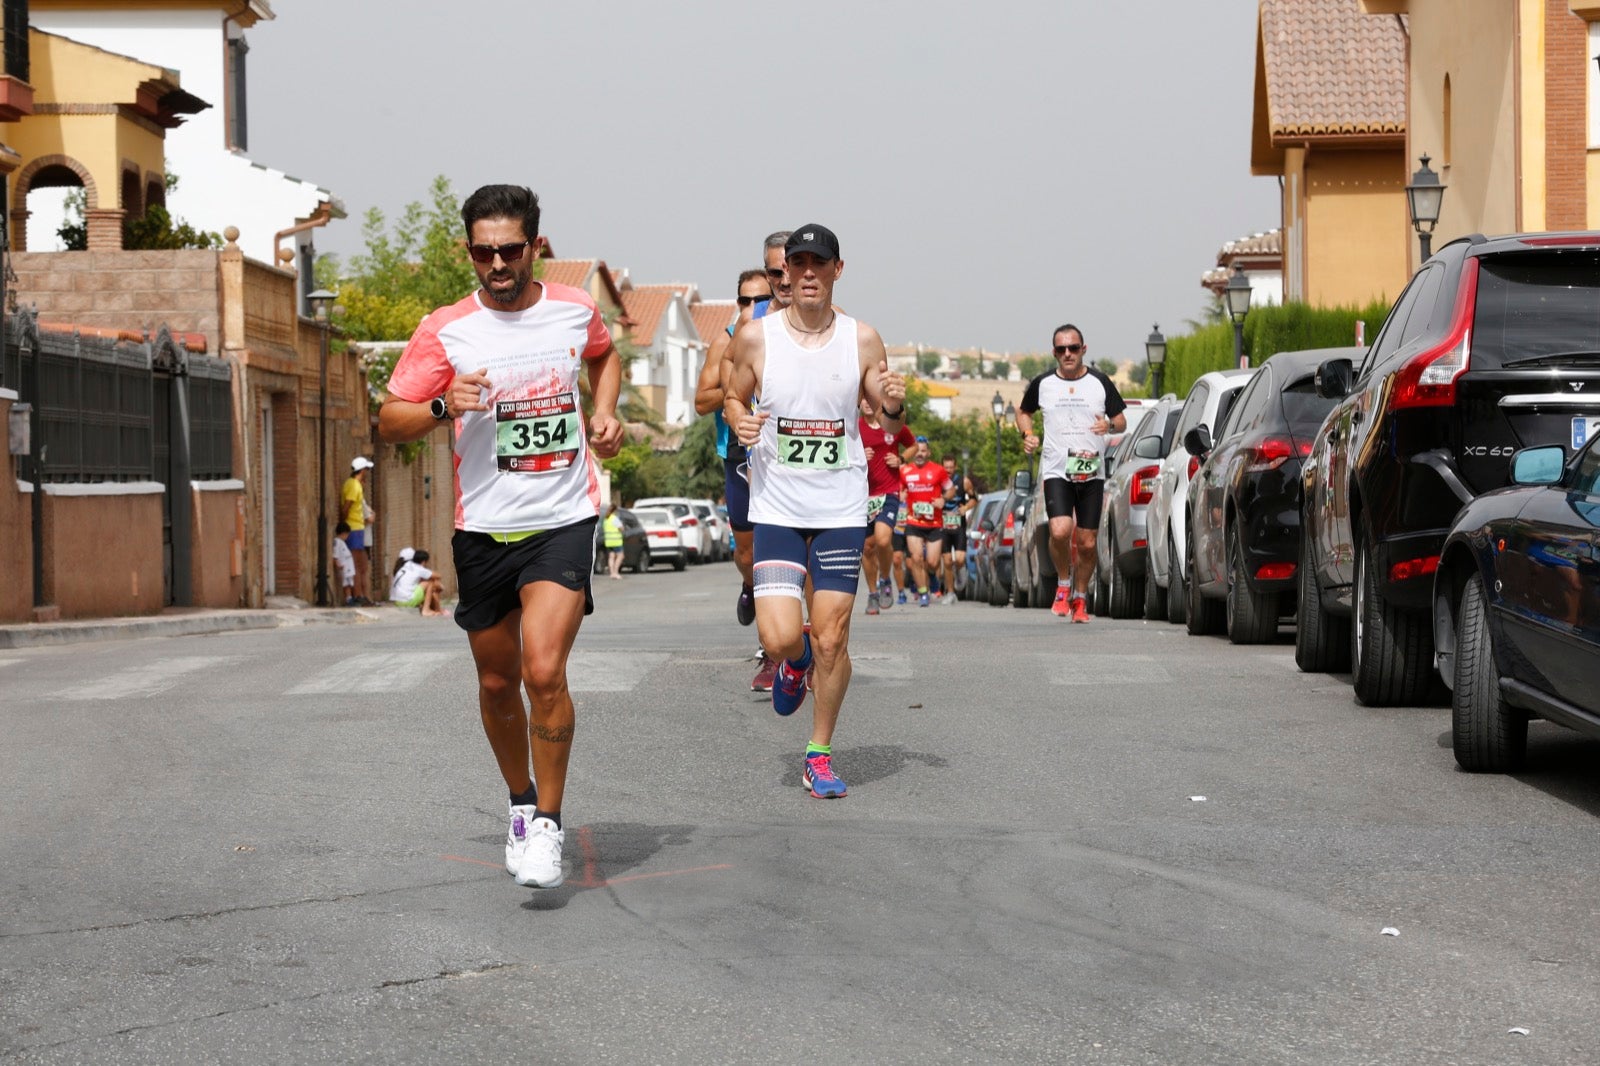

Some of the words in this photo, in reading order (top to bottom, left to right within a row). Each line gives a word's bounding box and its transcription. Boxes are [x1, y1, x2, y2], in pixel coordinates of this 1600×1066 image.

[516, 401, 531, 411] GRAN
[532, 399, 551, 409] PREMIO
[551, 397, 557, 406] DE
[793, 421, 806, 429] GRAN
[807, 421, 825, 430] PREMIO
[512, 418, 568, 450] 354
[1576, 436, 1583, 444] E
[787, 439, 839, 464] 273
[393, 569, 406, 588] 7
